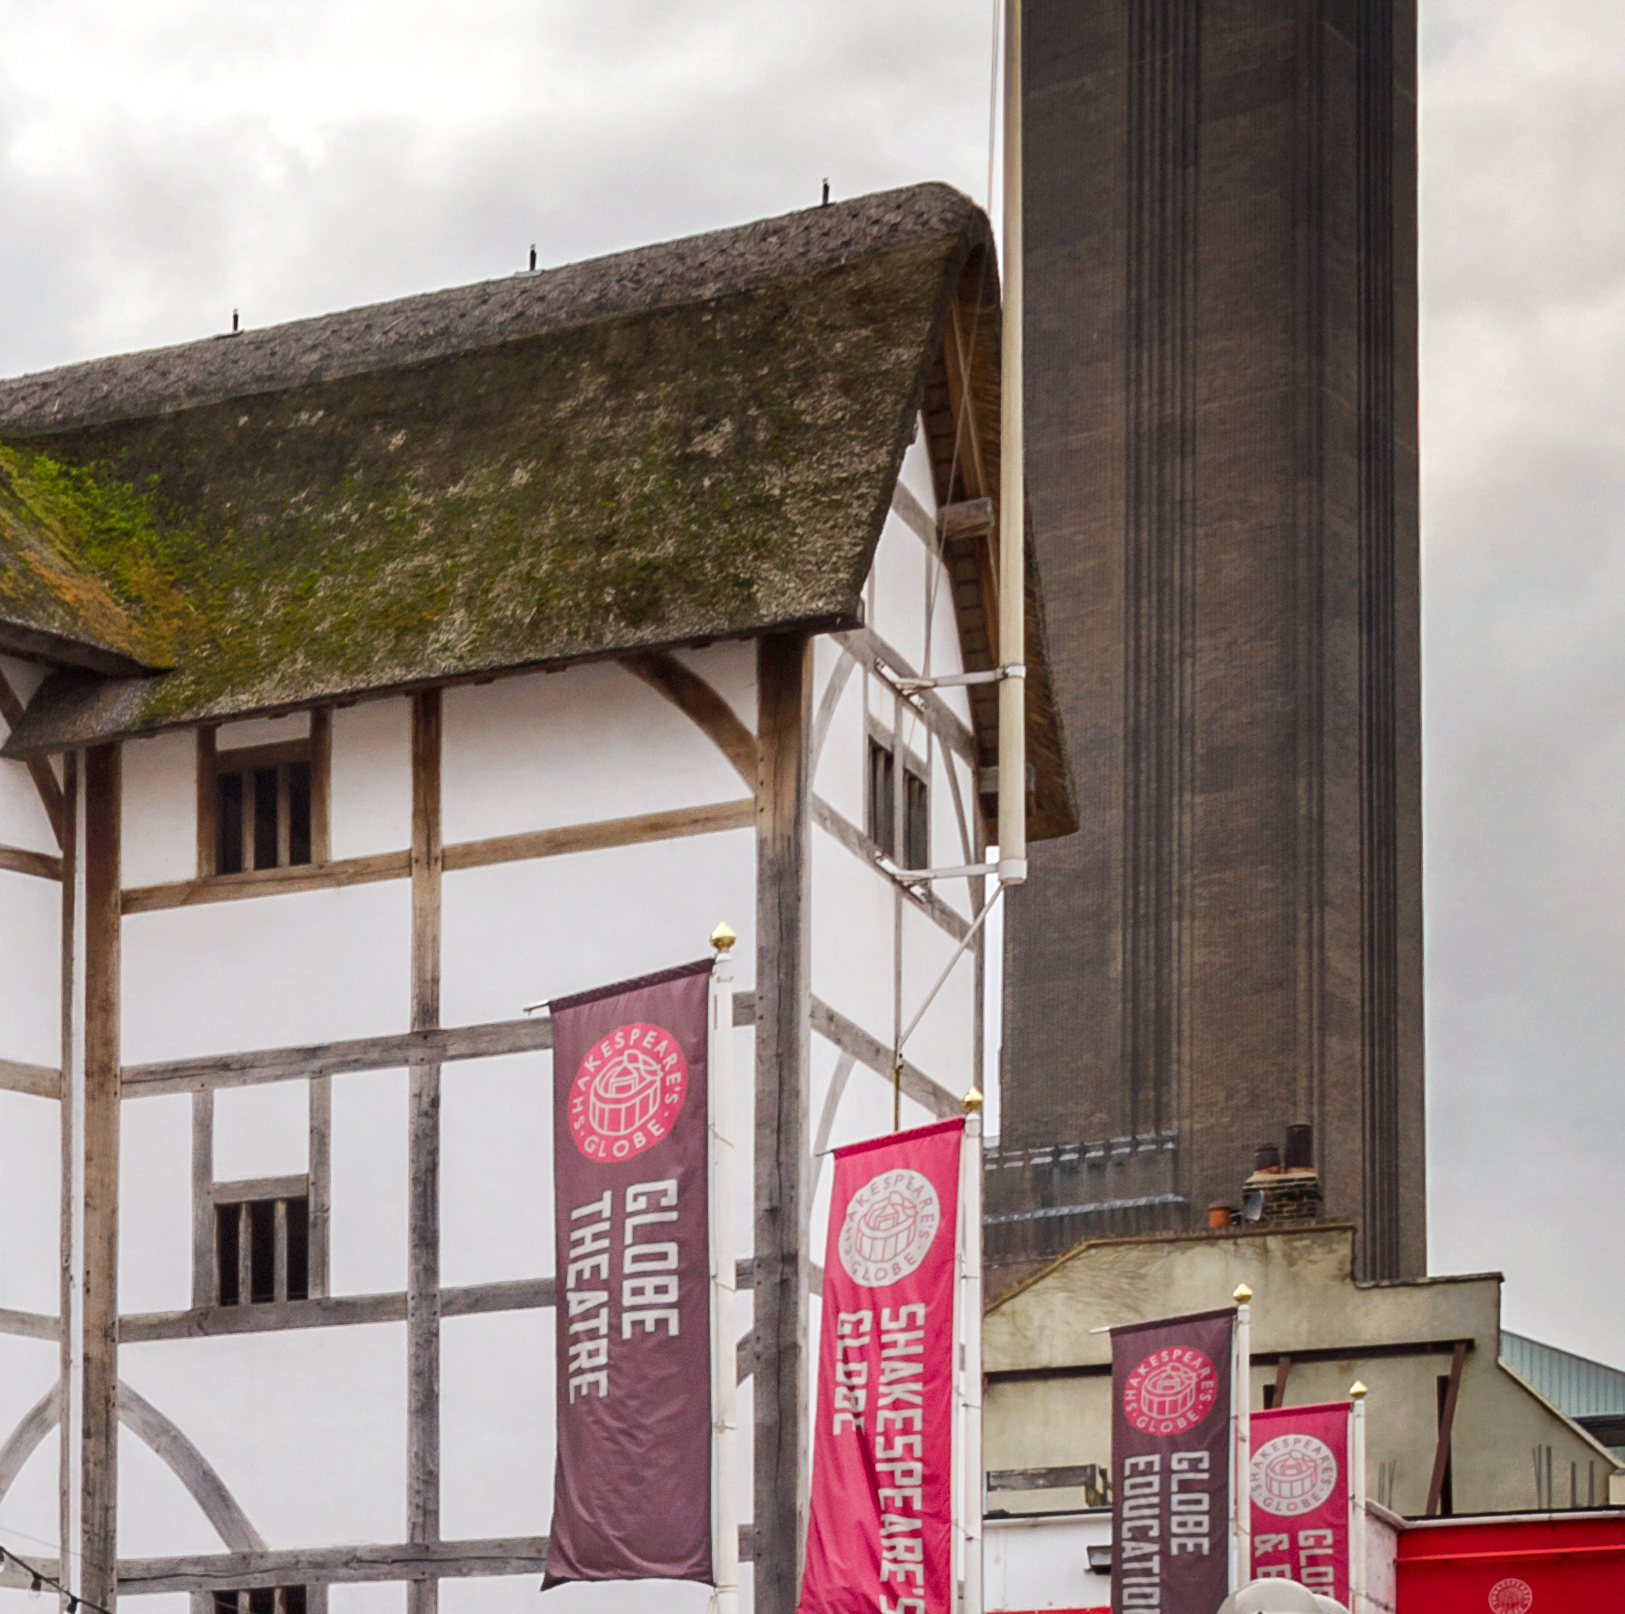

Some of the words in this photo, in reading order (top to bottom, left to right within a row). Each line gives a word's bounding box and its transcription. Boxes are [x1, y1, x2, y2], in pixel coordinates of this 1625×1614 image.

[571, 1028, 682, 1130] SHAKESPEARE'S
[583, 1119, 665, 1158] GLOBE
[568, 1188, 613, 1405] THEATRE
[620, 1177, 680, 1341] GLOBE
[1125, 1348, 1214, 1412] SHAKESPEARE'S
[1136, 1410, 1199, 1433] GLOBE
[1169, 1449, 1211, 1556] GLOBE
[1261, 1492, 1323, 1513] GLOBE
